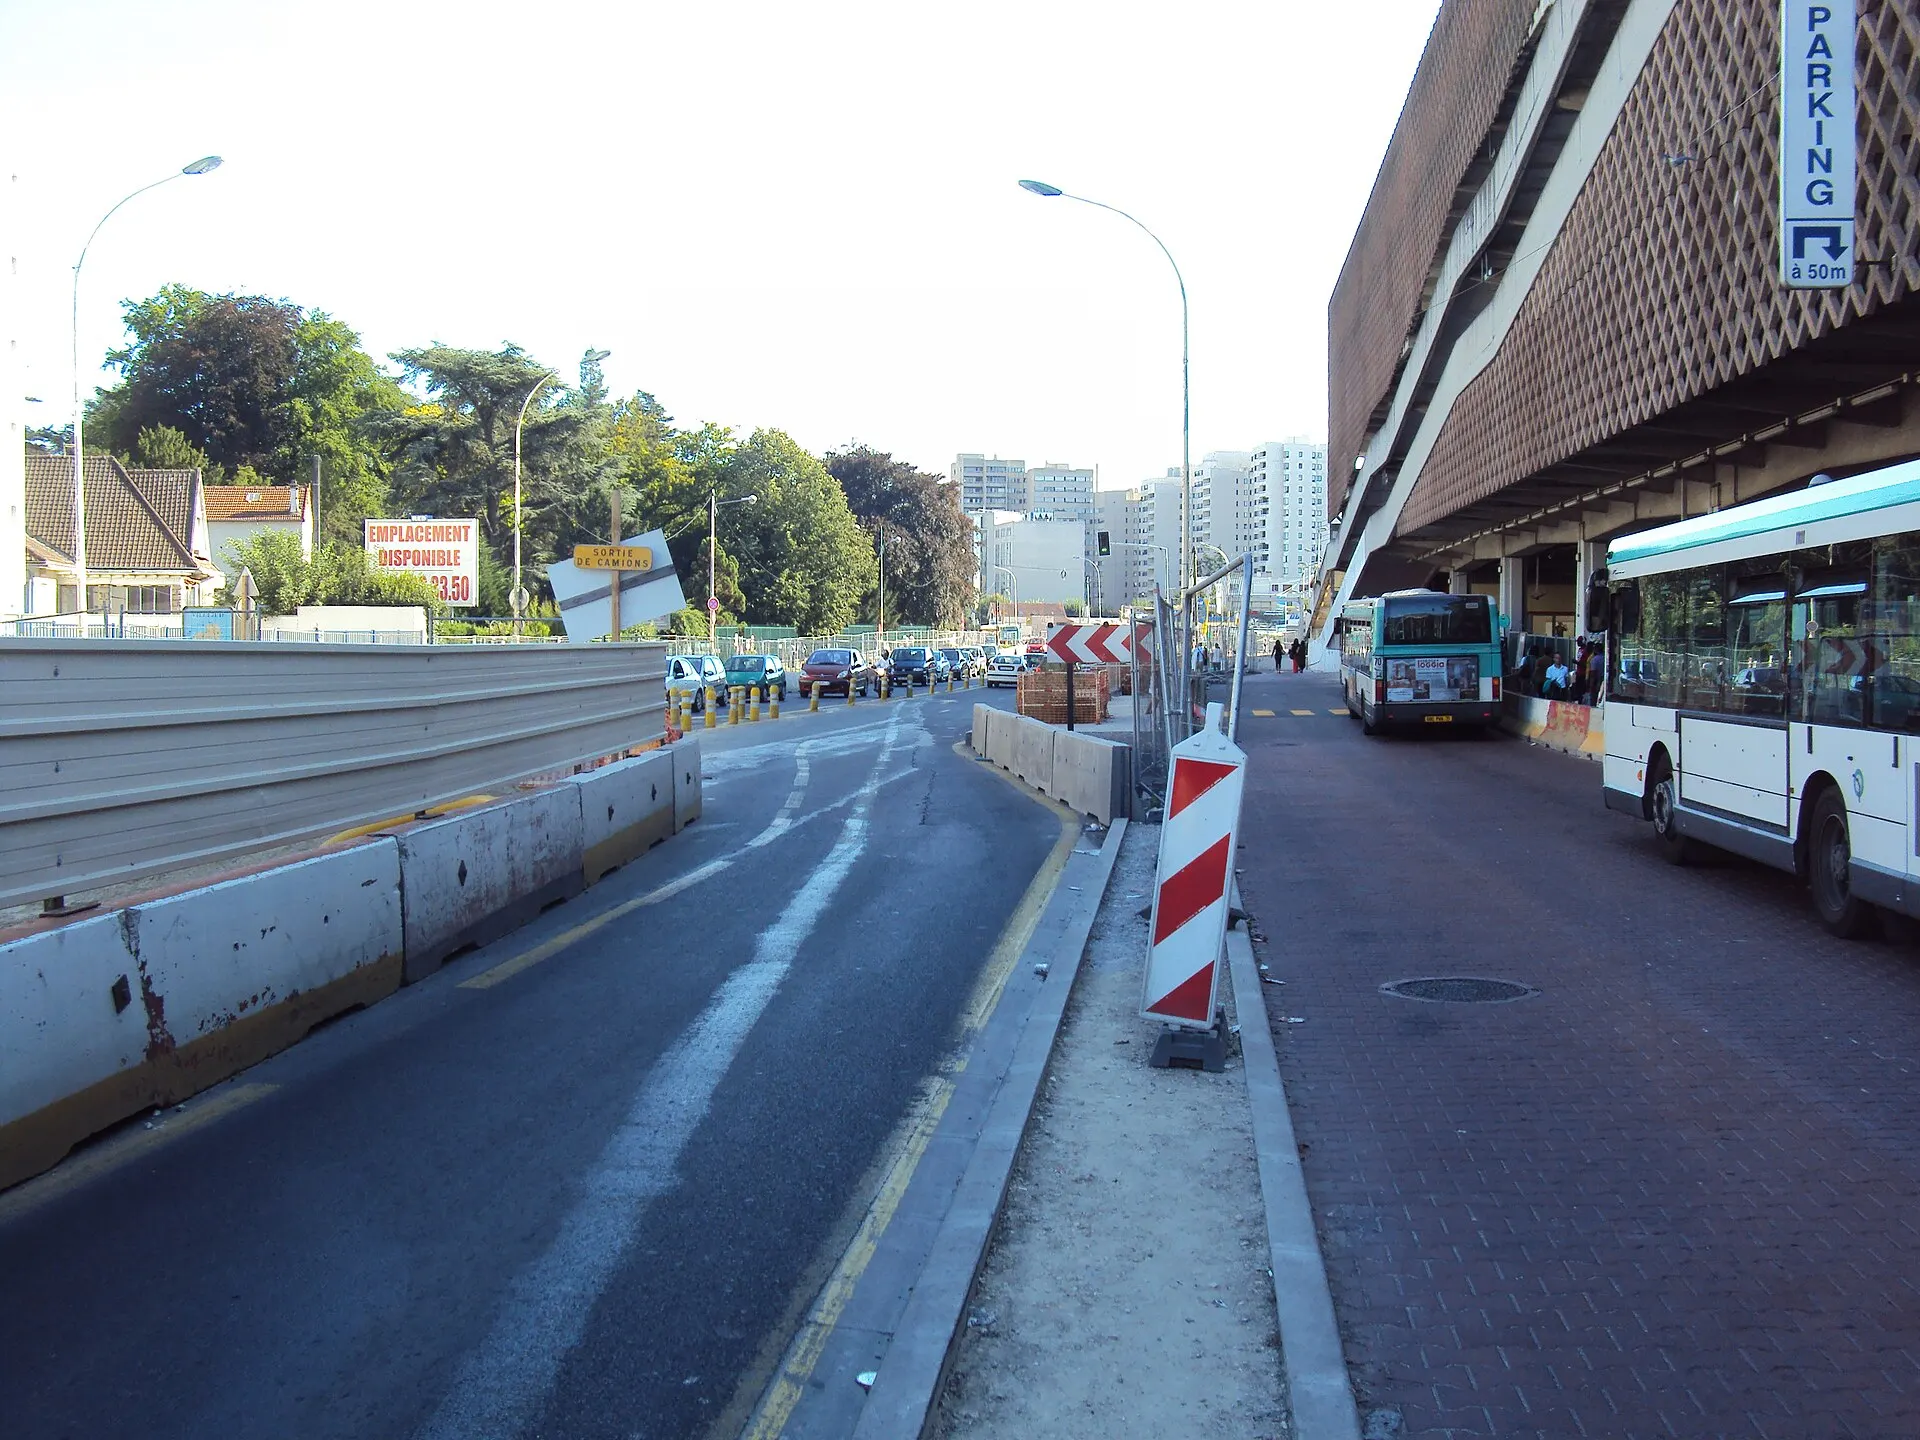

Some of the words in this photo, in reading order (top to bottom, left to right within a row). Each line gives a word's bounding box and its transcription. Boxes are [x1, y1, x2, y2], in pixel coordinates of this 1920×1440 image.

[1806, 6, 1834, 206] PARKING
[1791, 264, 1801, 279] à
[369, 525, 471, 542] EMPLACEMENT
[378, 549, 461, 567] DISPONIBLE
[593, 548, 633, 558] SORTIE
[577, 558, 591, 566] DE
[597, 558, 649, 568] CAMIONS
